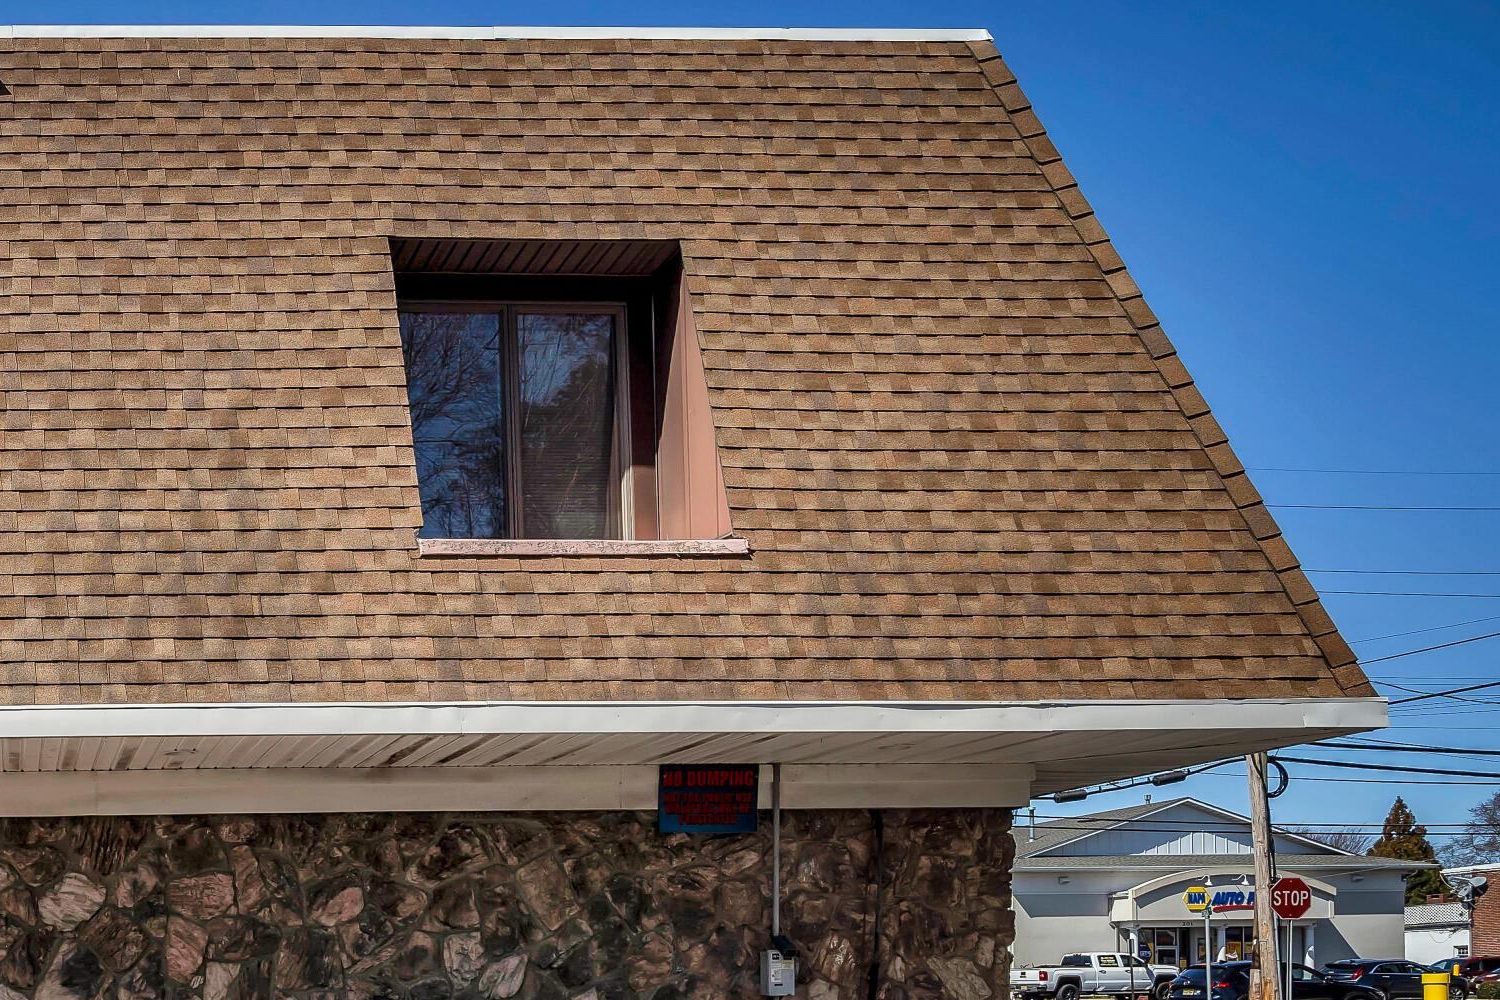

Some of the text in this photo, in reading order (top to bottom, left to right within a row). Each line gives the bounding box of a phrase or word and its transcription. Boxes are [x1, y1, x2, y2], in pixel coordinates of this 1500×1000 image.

[663, 769, 755, 786] NO DUMPING
[1188, 892, 1206, 904] NAPA
[1211, 891, 1245, 906] AUTO
[1273, 890, 1309, 907] STOP
